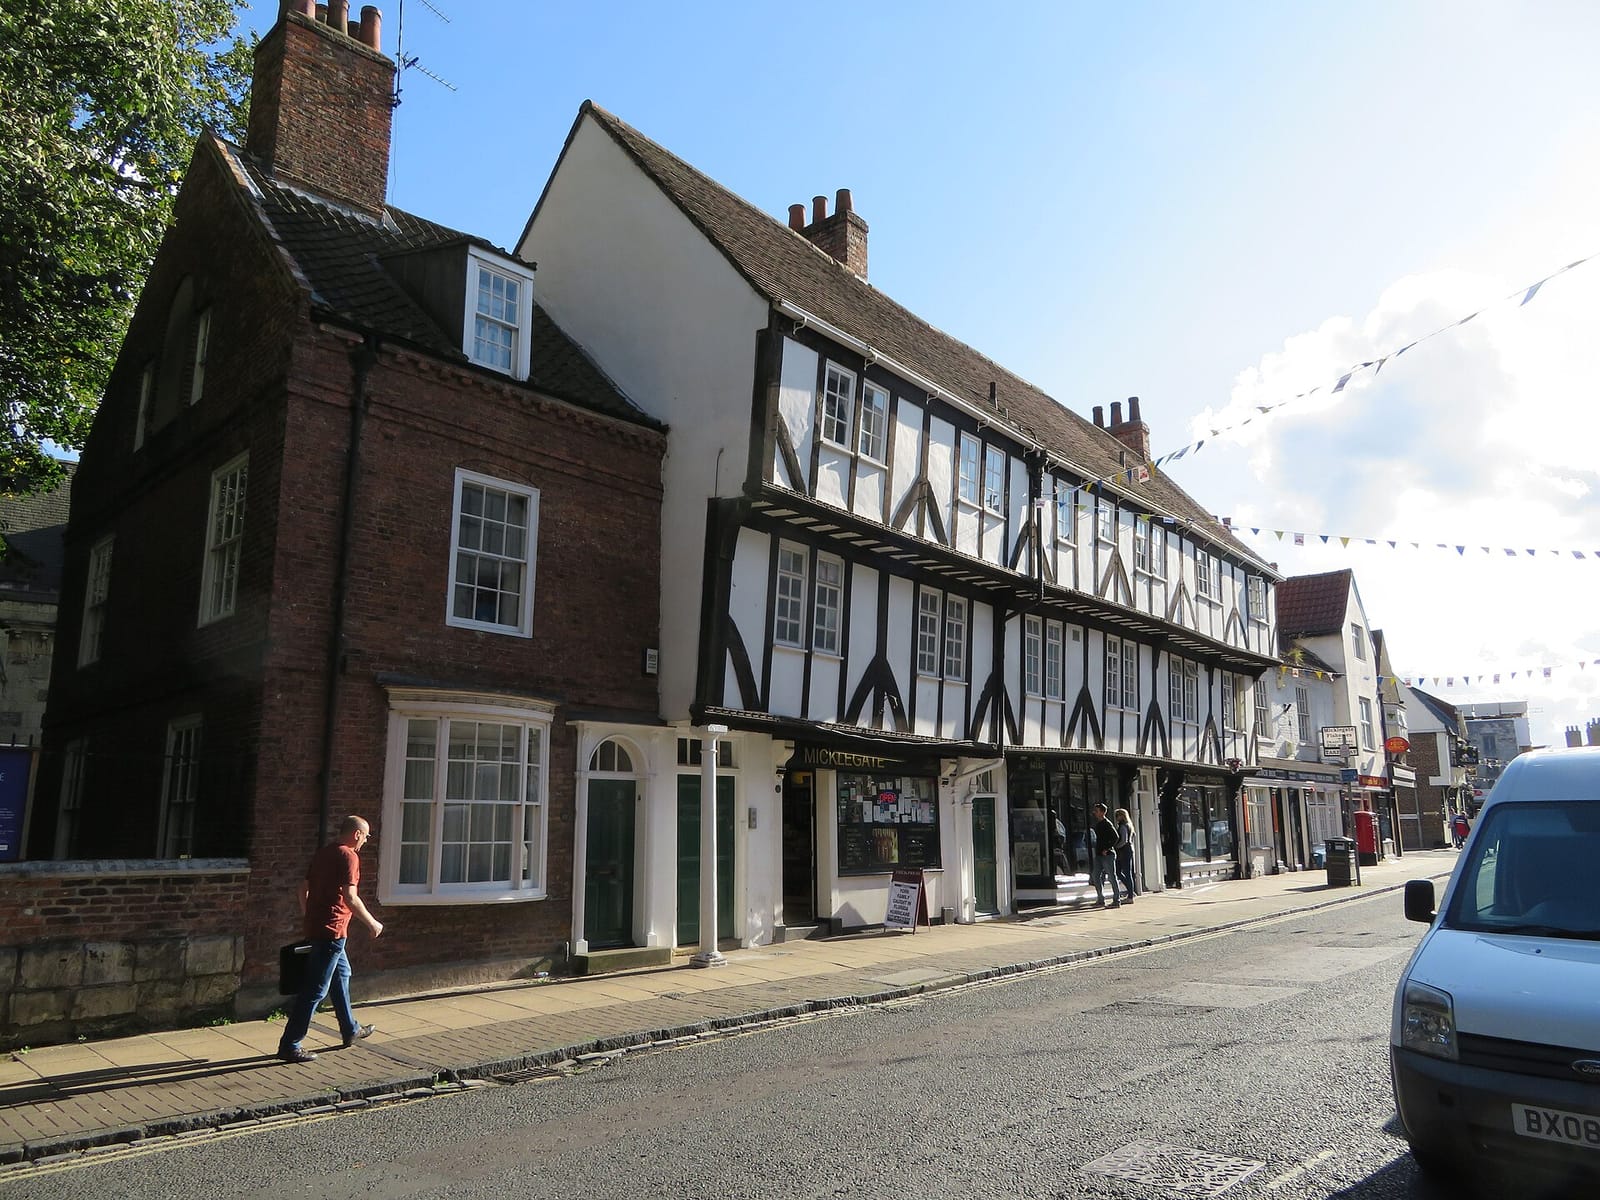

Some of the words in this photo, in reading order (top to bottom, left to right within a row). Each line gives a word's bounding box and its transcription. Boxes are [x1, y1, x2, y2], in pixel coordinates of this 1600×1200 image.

[803, 747, 885, 769] MICKLEGATE
[1055, 759, 1094, 774] ANTIQUES
[880, 793, 897, 804] OPEN
[1524, 1109, 1600, 1144] BX08
